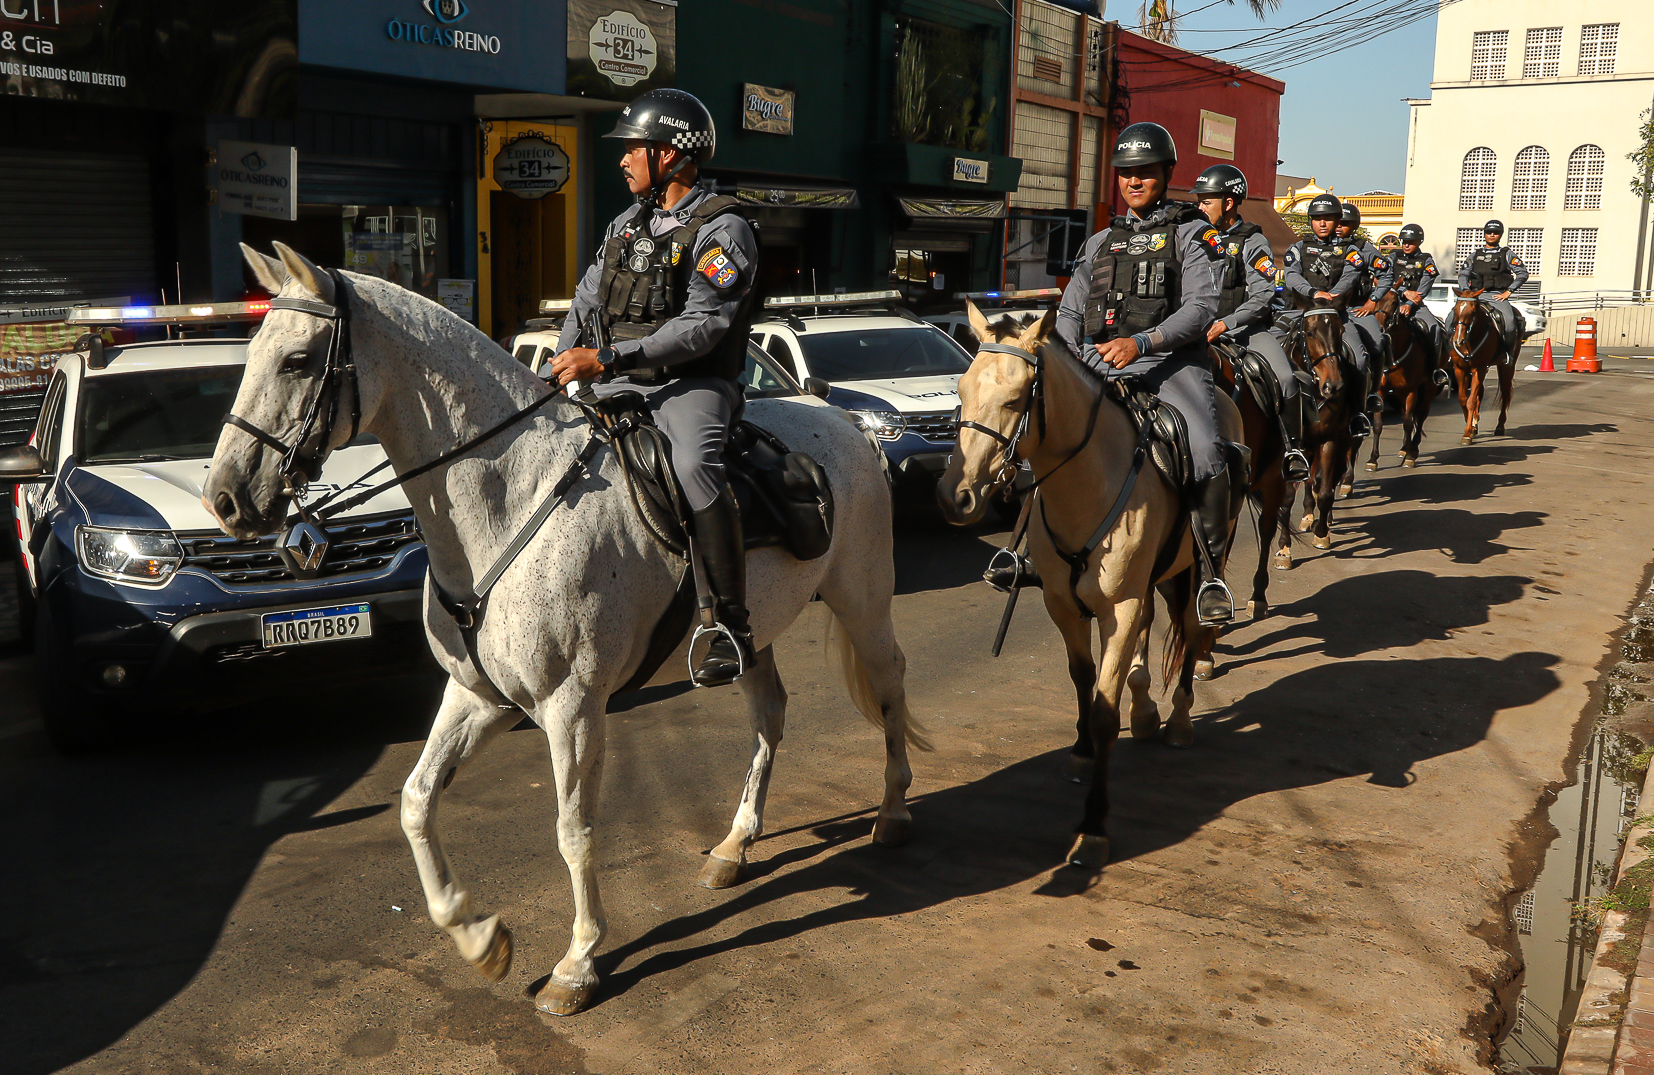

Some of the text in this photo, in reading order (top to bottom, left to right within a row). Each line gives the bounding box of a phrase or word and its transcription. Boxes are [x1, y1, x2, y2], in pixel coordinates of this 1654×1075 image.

[22, 35, 54, 55] Cia
[614, 39, 633, 59] 34
[22, 64, 28, 77] E
[29, 64, 68, 81] USADOS
[69, 69, 91, 84] COM
[92, 72, 127, 88] DEFEITO
[601, 61, 646, 75] Centro Comercial
[748, 94, 783, 119] Bugre
[658, 114, 690, 131] AVALARIA
[1117, 140, 1152, 151] POLÍCIA
[520, 161, 540, 177] 34
[956, 159, 981, 180] Bugre
[526, 180, 555, 188] Comercial
[272, 615, 360, 644] RRQ7B89
